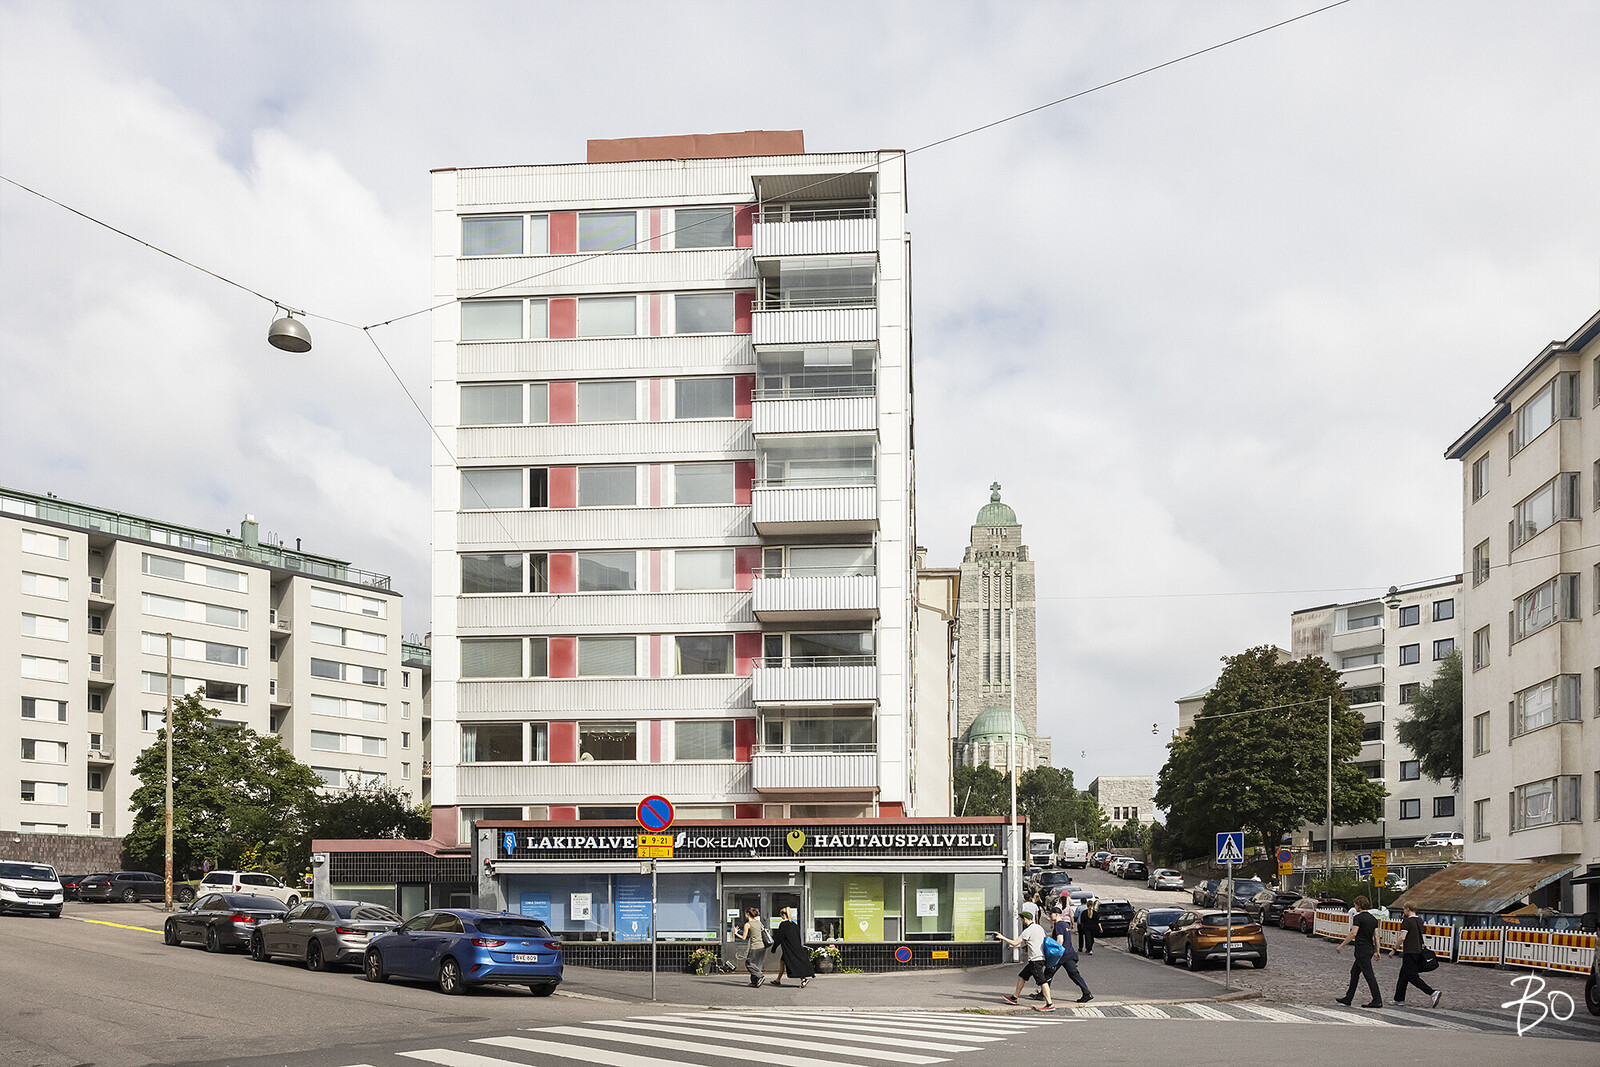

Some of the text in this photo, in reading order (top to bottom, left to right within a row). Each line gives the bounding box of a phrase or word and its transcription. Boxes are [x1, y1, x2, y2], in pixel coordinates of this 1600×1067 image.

[527, 836, 638, 849] LAKIPALVE
[687, 836, 771, 848] HOK-ELANTO
[1360, 854, 1371, 868] P
